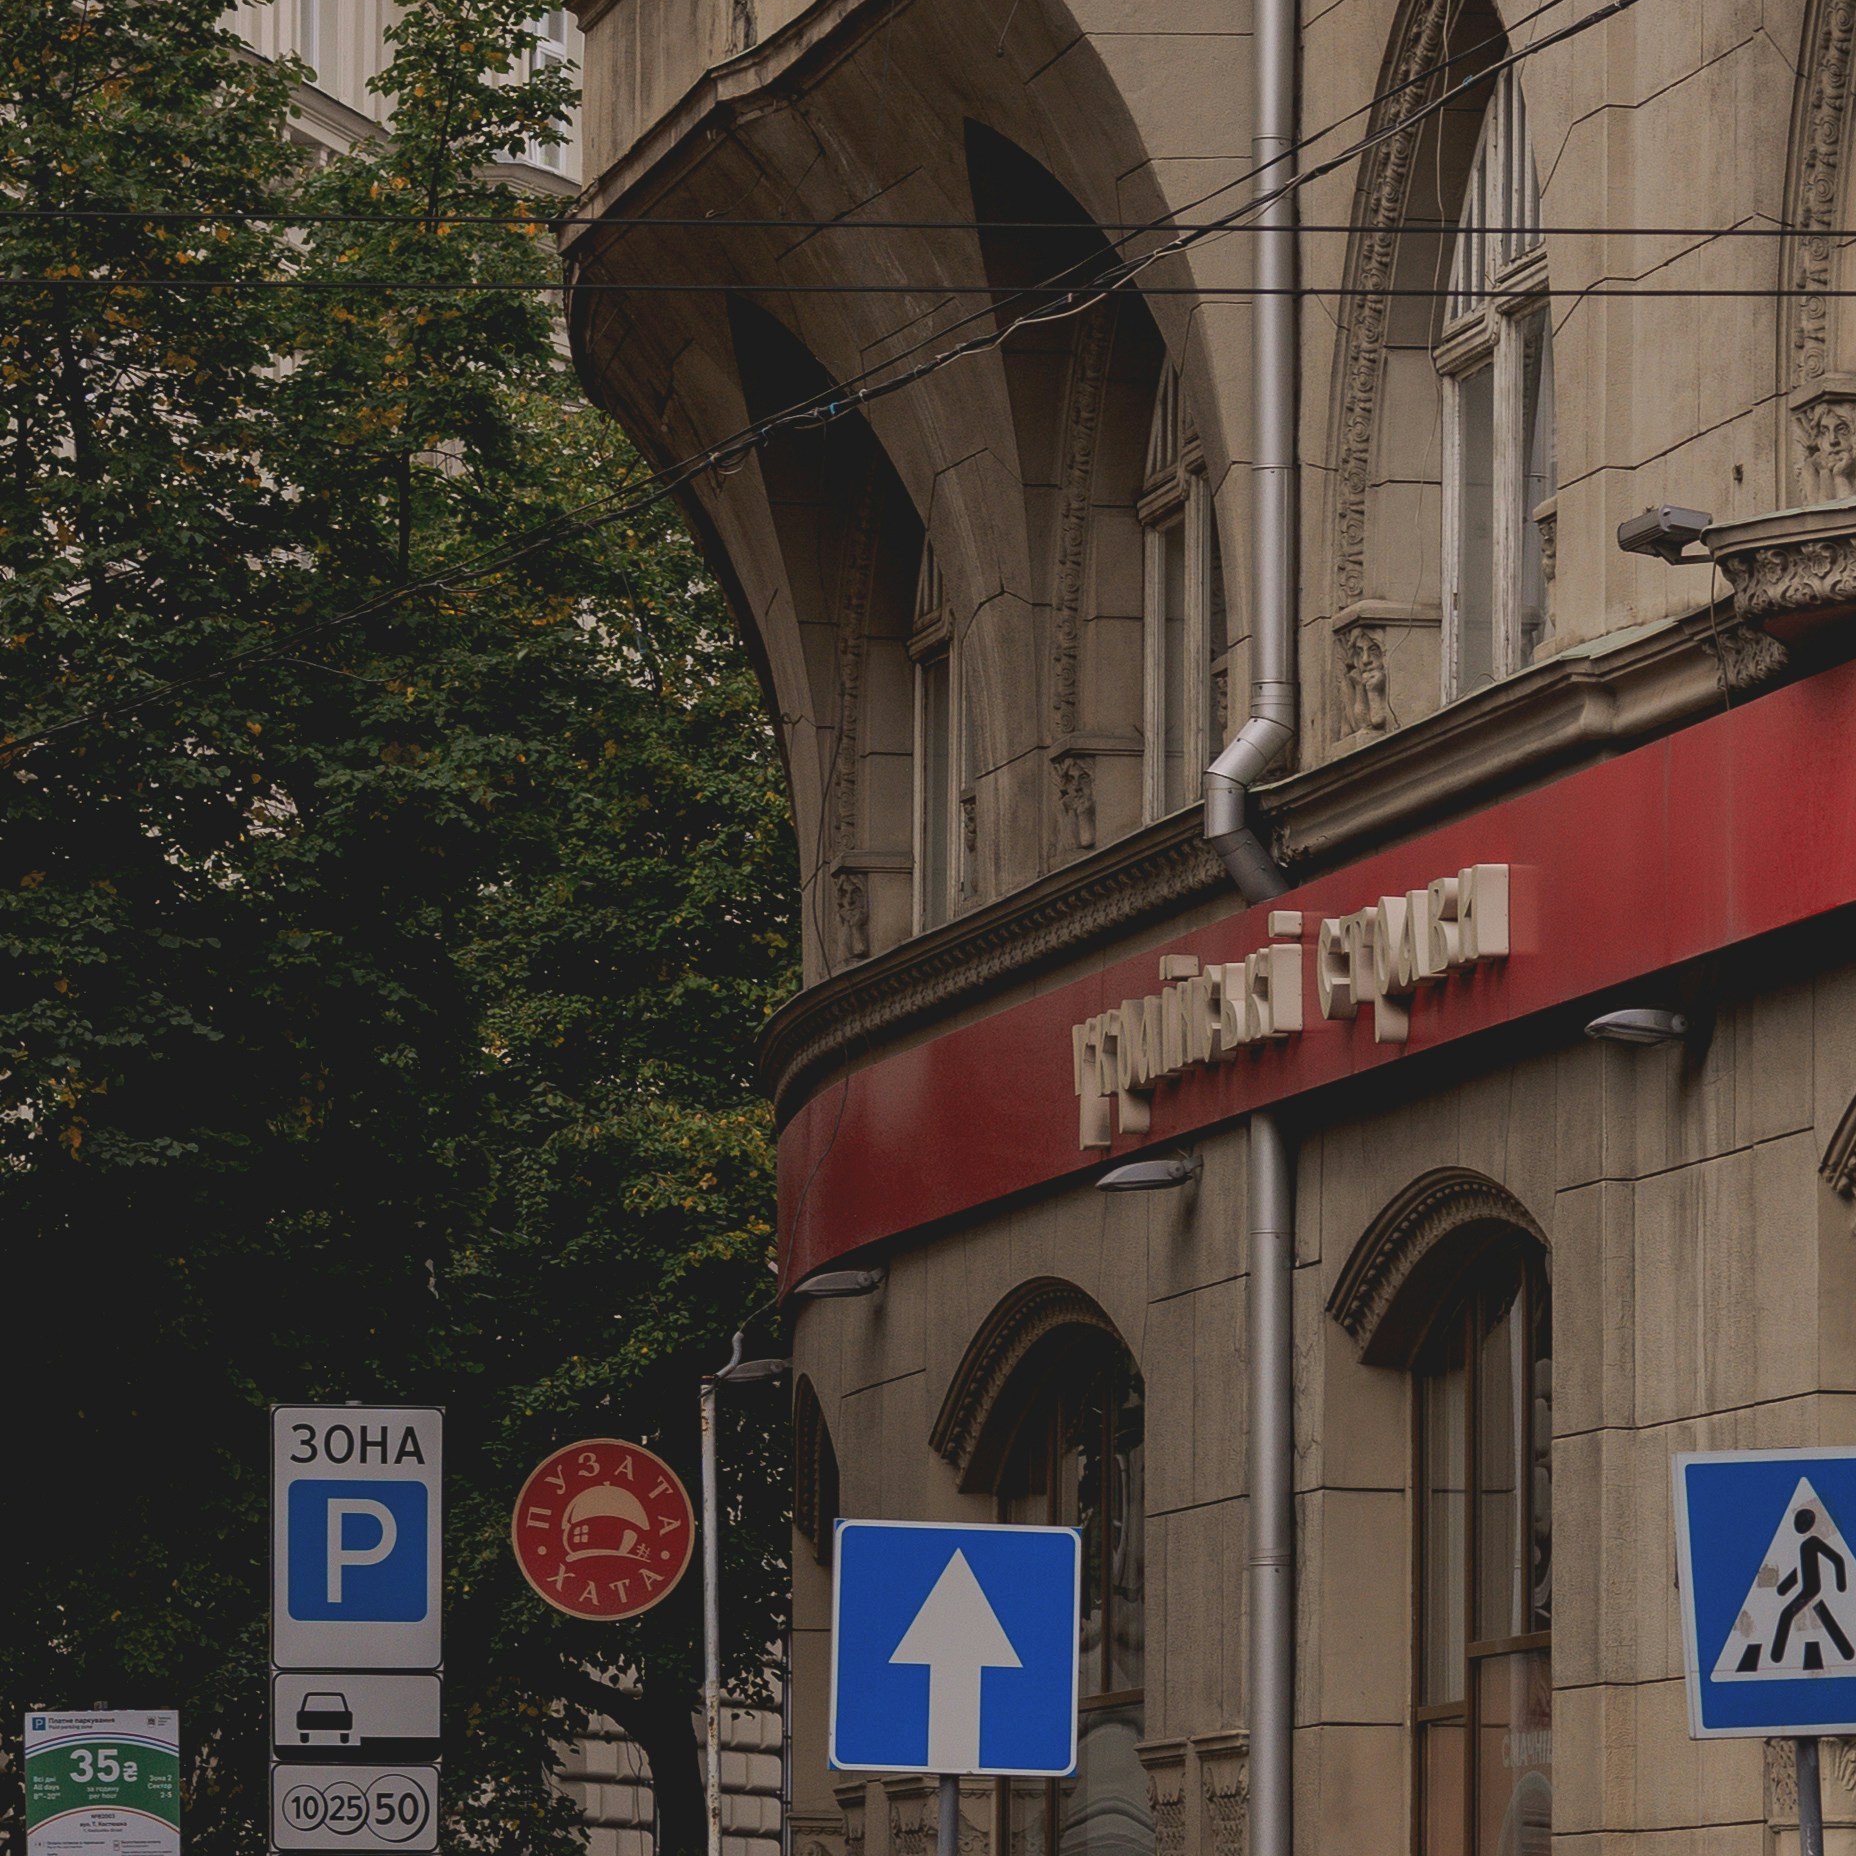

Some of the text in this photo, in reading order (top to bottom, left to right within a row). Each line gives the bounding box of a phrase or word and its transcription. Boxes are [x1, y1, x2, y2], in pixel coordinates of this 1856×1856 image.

[291, 1424, 426, 1465] ЗОНА
[527, 1451, 682, 1531] ПУЗАТА
[326, 1497, 398, 1603] P
[546, 1562, 664, 1607] ХАТА
[292, 1791, 420, 1824] 10 25 50
